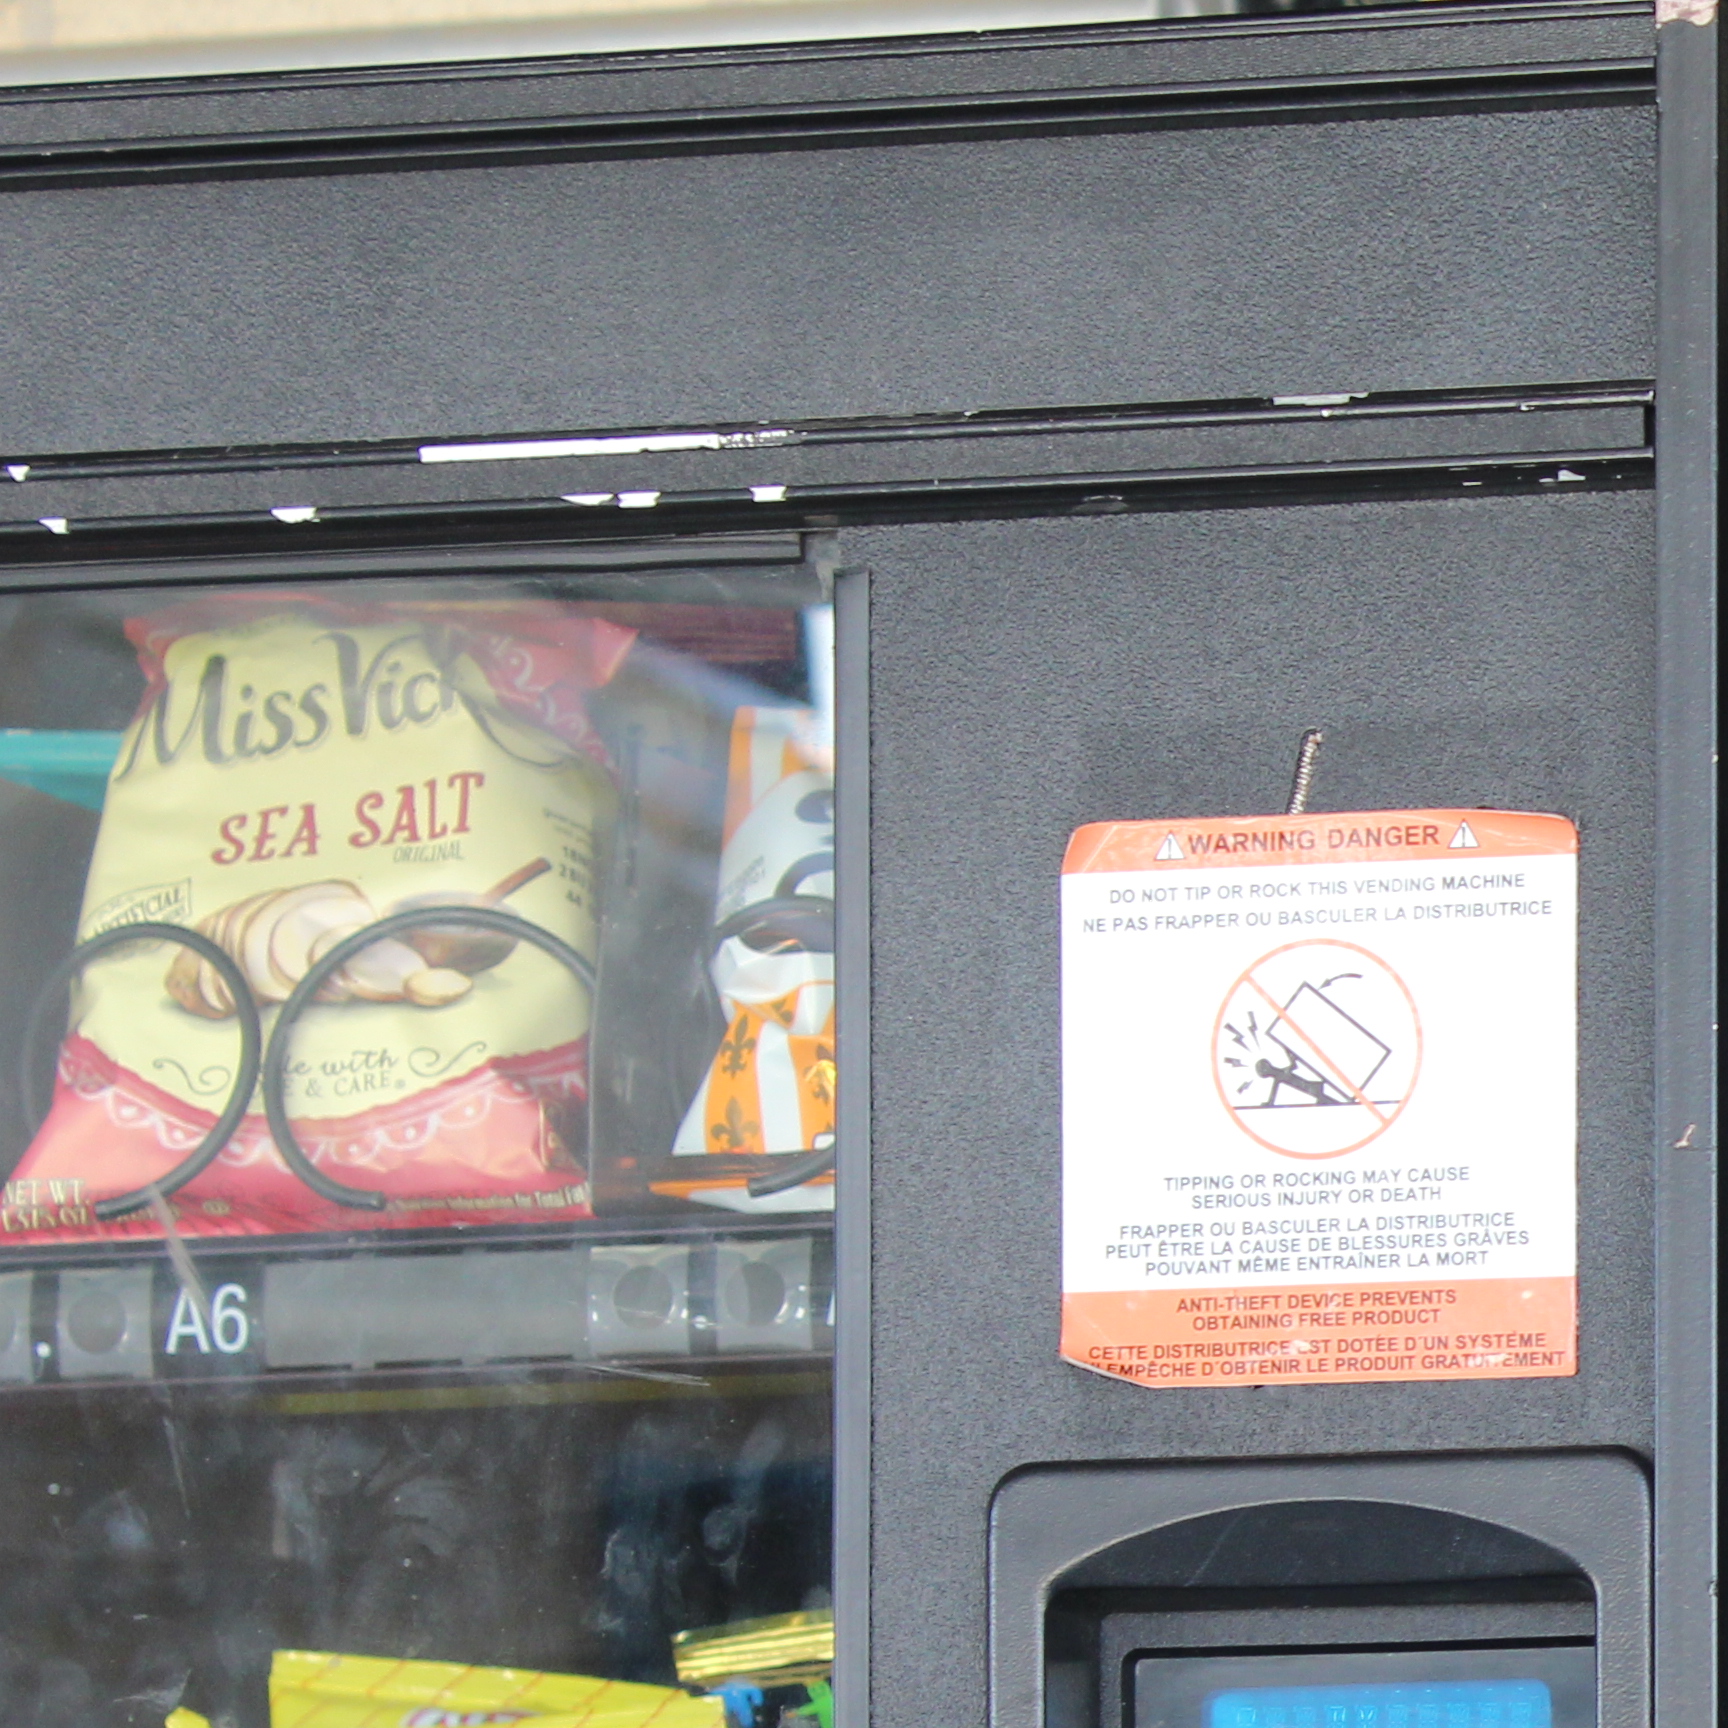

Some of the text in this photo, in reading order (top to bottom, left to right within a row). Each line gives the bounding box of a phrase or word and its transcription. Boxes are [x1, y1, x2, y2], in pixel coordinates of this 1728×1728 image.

[114, 654, 330, 782] Miss
[211, 803, 321, 866] SEA
[348, 771, 485, 849] SALT
[393, 841, 465, 864] ORIGINAL
[1188, 825, 1440, 854] WARNING DANGER
[1110, 873, 1525, 904] DO NOT TIP OR ROCK THIS VENDING MACHINE
[1083, 900, 1552, 933] NE PAS FRAPPER OU BASCULER LA DISTRIBUTRICE
[321, 1049, 399, 1076] with
[333, 1070, 392, 1097] CARE
[5, 1179, 41, 1205] NET
[1164, 1166, 1470, 1191] TIPPING OR ROCKING MAY CAUSE
[1191, 1186, 1442, 1209] SERIOUS INJURY OR DEATH
[1120, 1212, 1515, 1240] FRAPPER OU BASCULER LA DISTRIBUTRICE
[1106, 1243, 1152, 1259] PEUT
[1158, 1240, 1205, 1257] ÊTRE
[1211, 1241, 1234, 1255] LA
[1239, 1237, 1301, 1254] CAUSE
[1308, 1236, 1332, 1252] DE
[1338, 1233, 1448, 1251] BLESSURES
[1145, 1250, 1489, 1276] POUVANT MÊME ENTRAÎNER LA MORT
[1176, 1288, 1457, 1313] ANTI-THEFT DEVICE PREVENTS
[165, 1284, 249, 1354] A6
[1193, 1308, 1441, 1331] OBTAINING FREE PRODUCT
[1089, 1343, 1147, 1361] CETTE
[1153, 1339, 1290, 1360] DISTRIBUTRICE
[1338, 1334, 1399, 1354] DOTÉE
[1307, 1358, 1329, 1372] LE
[1335, 1354, 1415, 1372] PRODUIT
